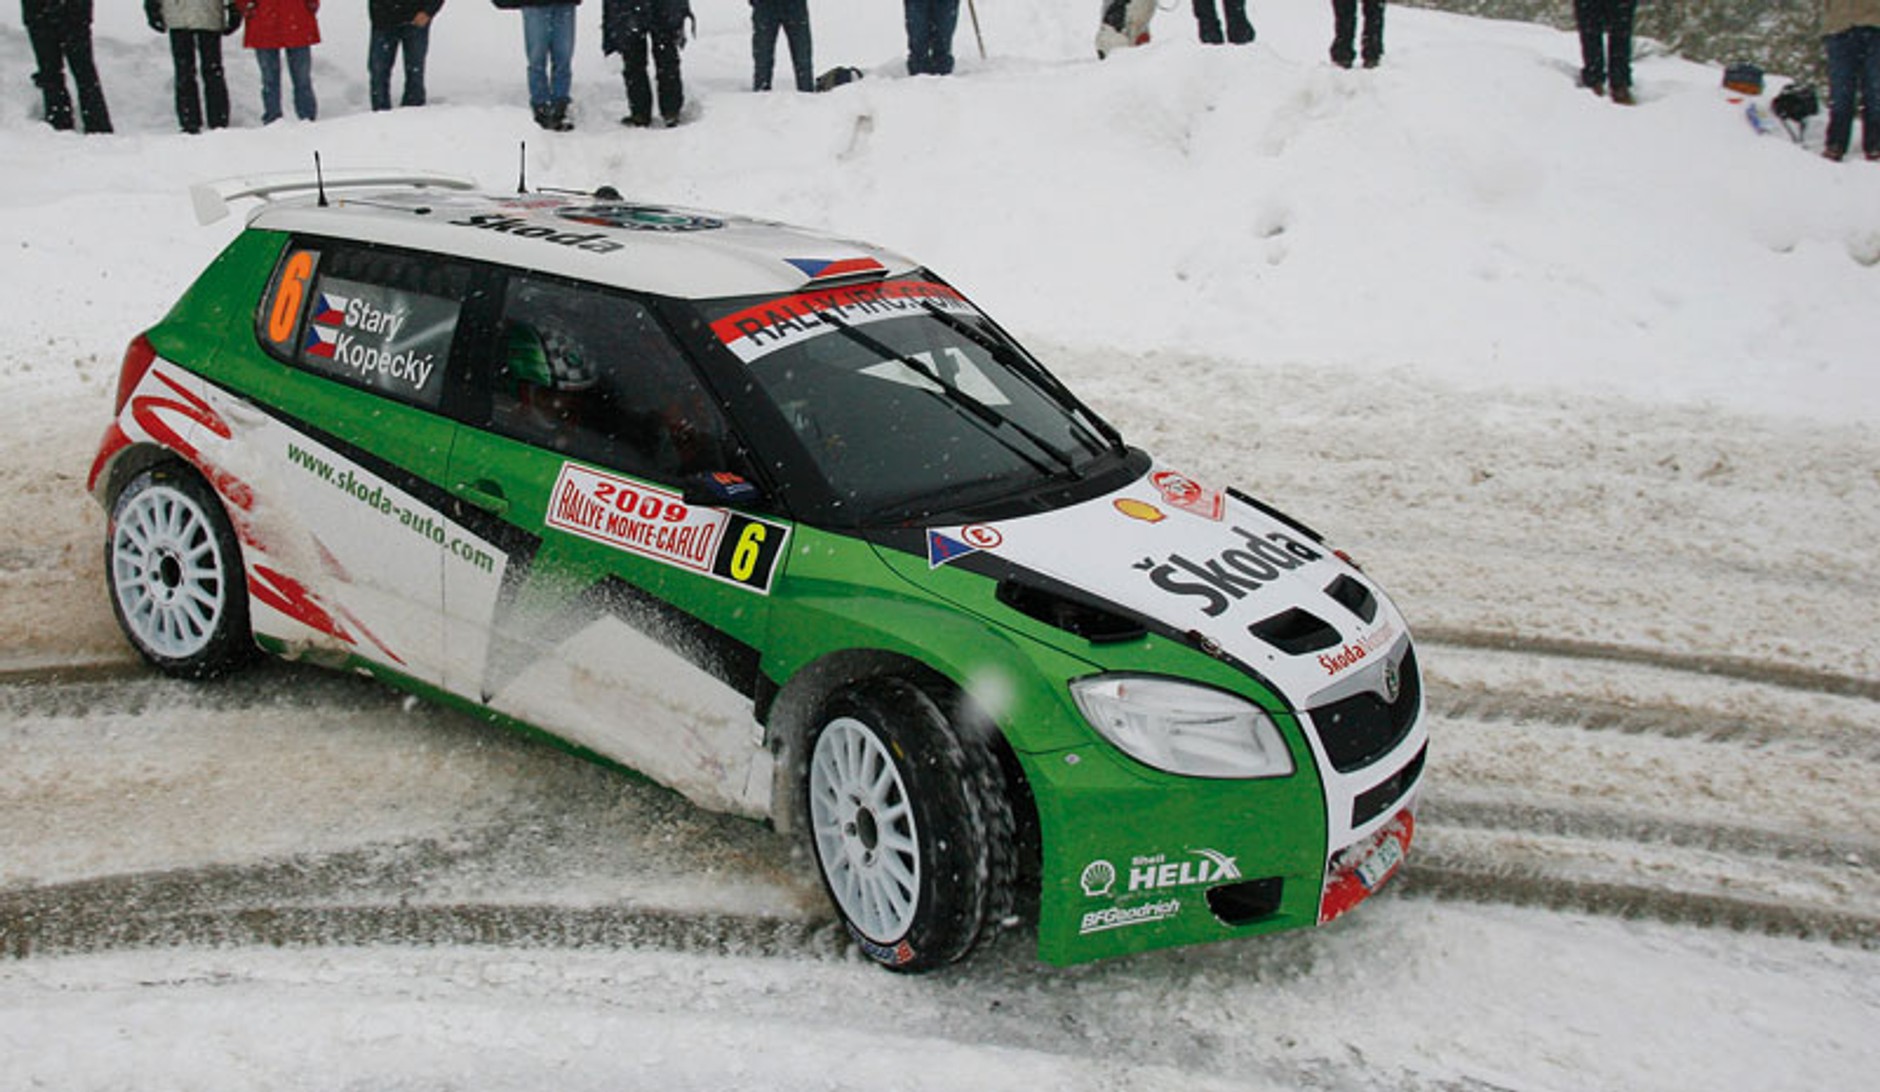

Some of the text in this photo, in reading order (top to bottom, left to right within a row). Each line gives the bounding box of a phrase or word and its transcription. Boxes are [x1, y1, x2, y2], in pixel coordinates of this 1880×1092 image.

[269, 250, 313, 343] 6
[344, 297, 404, 342] Starý
[333, 332, 434, 390] Kopecký
[287, 443, 495, 573] www.skoda-auto.com
[557, 479, 715, 563] RALLYE MONTE-CARLO
[594, 482, 688, 523] 2009
[730, 523, 766, 581] 6
[1132, 526, 1323, 618] Škoda
[1128, 848, 1242, 891] HELIX
[1132, 854, 1165, 866] Shell
[1081, 899, 1180, 930] BFGoodrich
